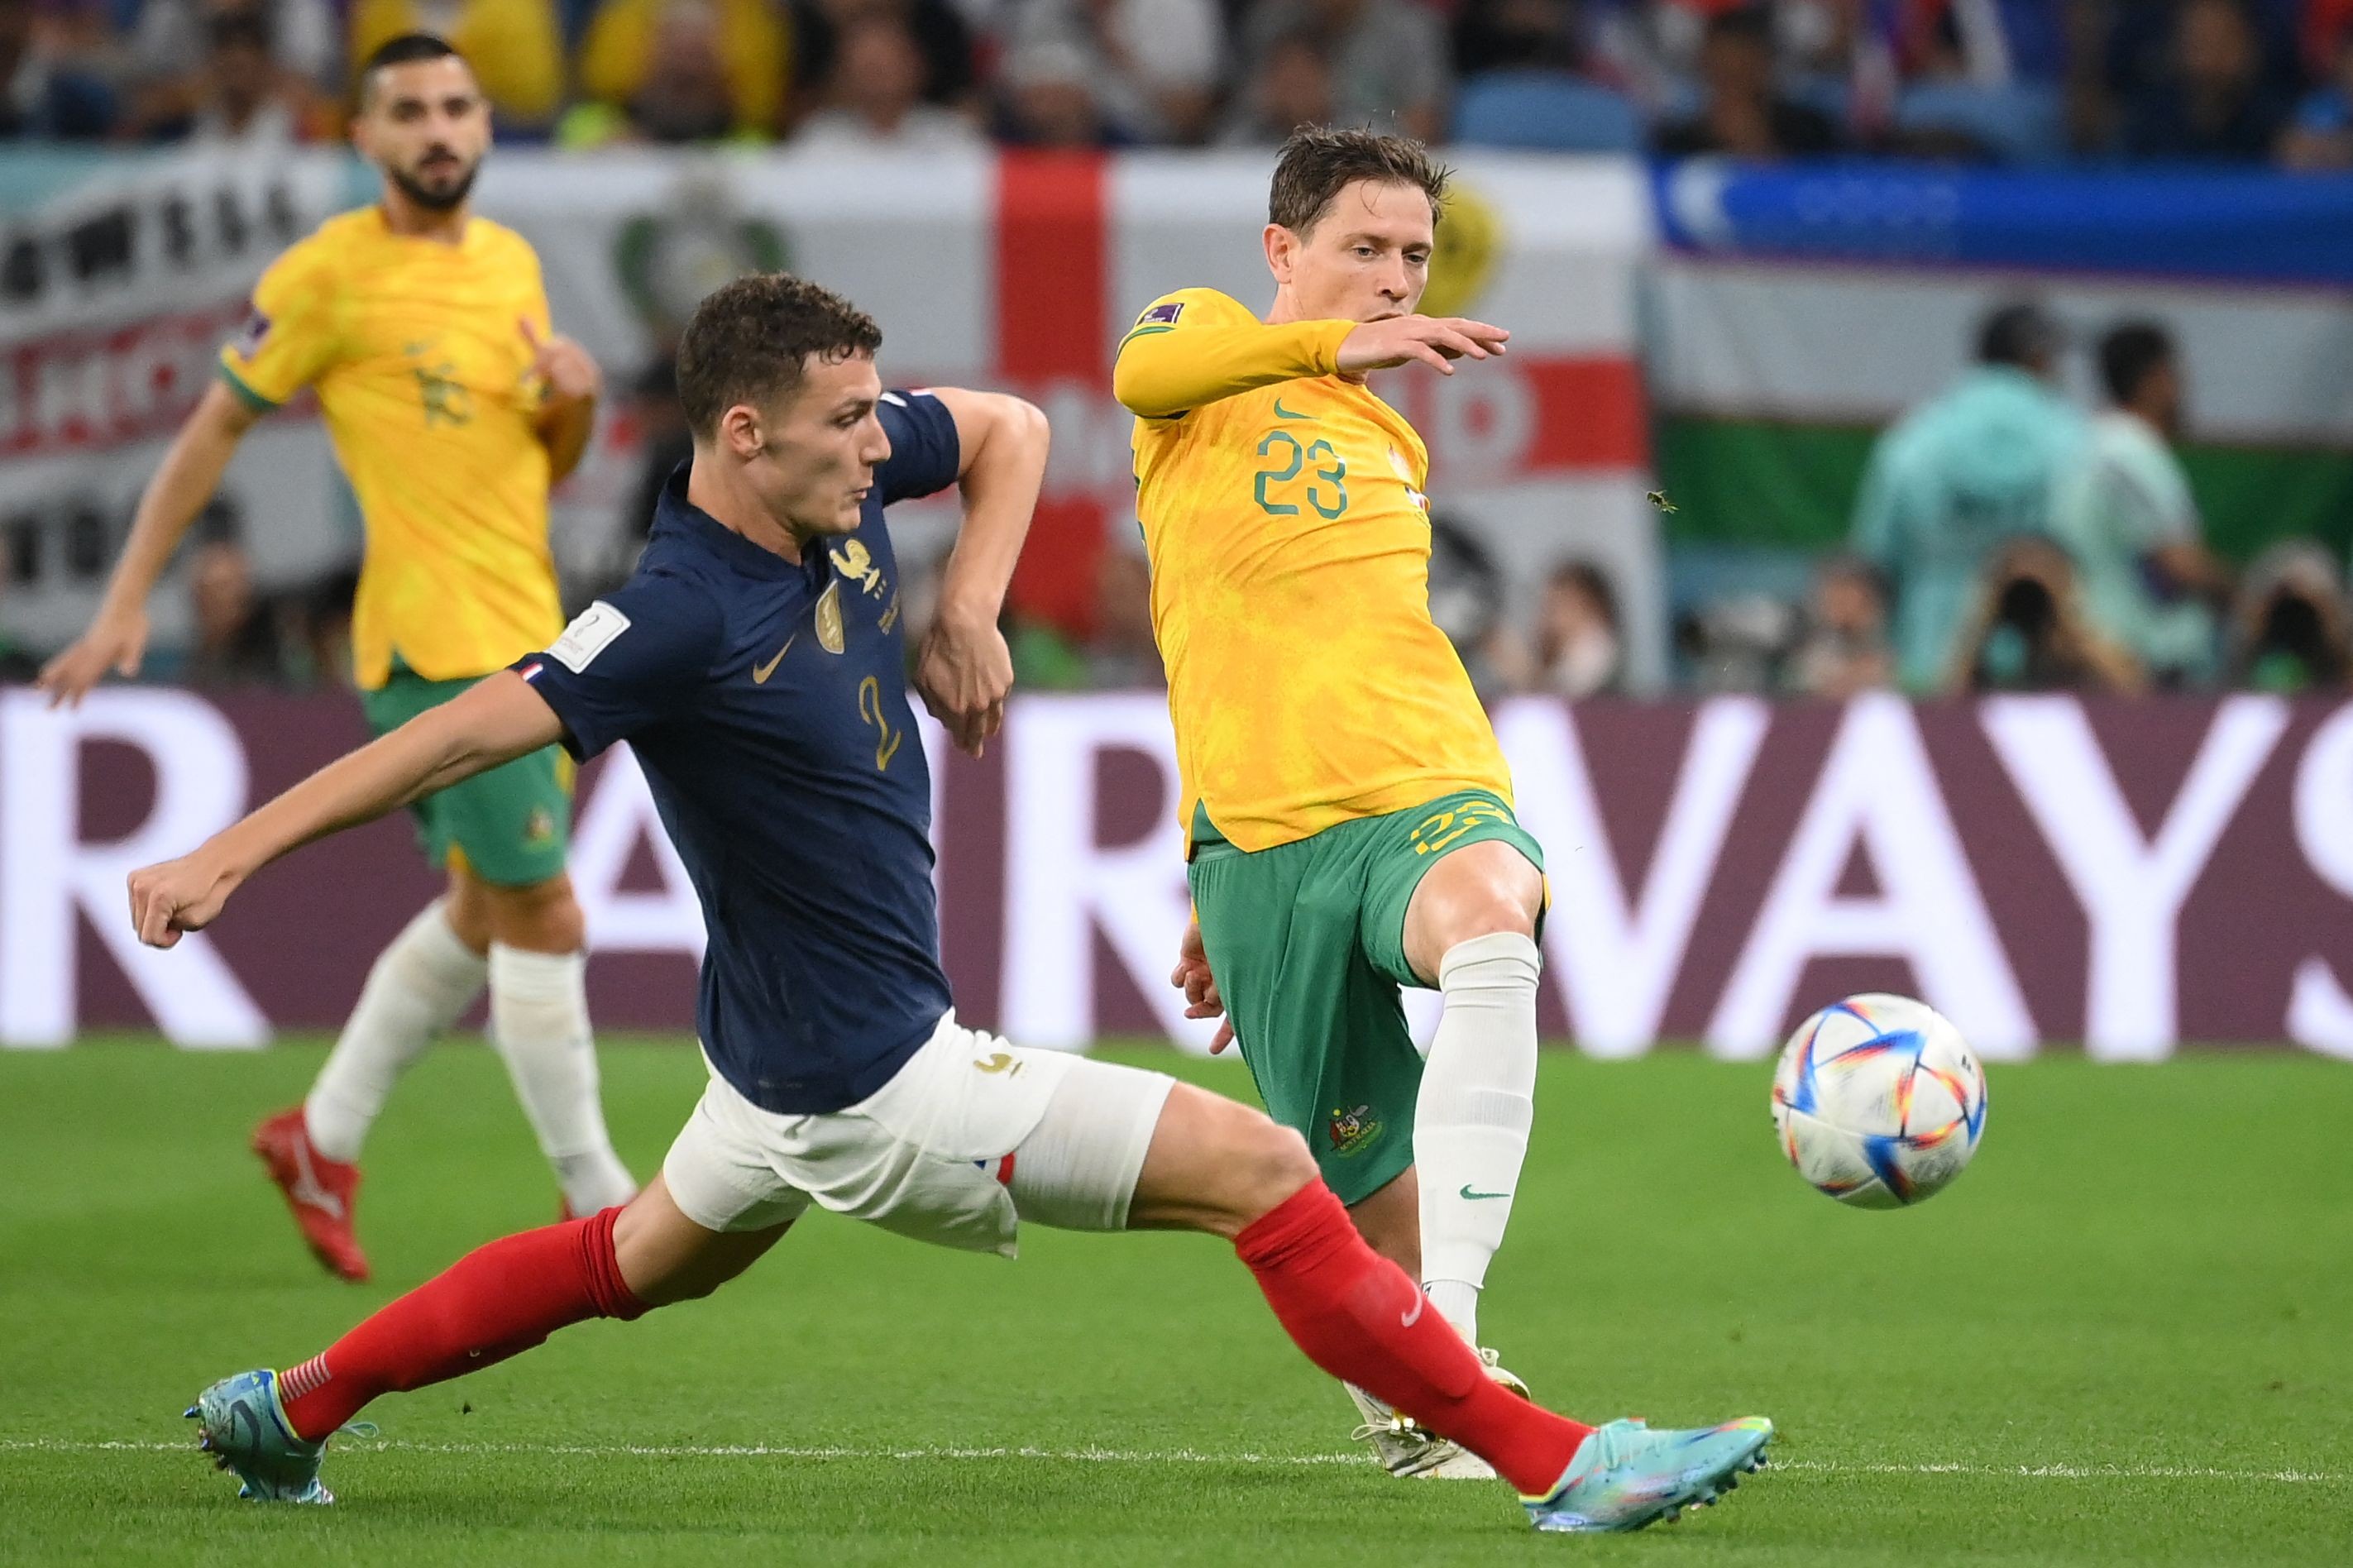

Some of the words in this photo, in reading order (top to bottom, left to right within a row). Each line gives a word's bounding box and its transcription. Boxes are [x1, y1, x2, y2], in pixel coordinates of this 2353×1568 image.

[1254, 430, 1348, 520] 23
[858, 674, 902, 772] 2
[1410, 801, 1513, 856] 23
